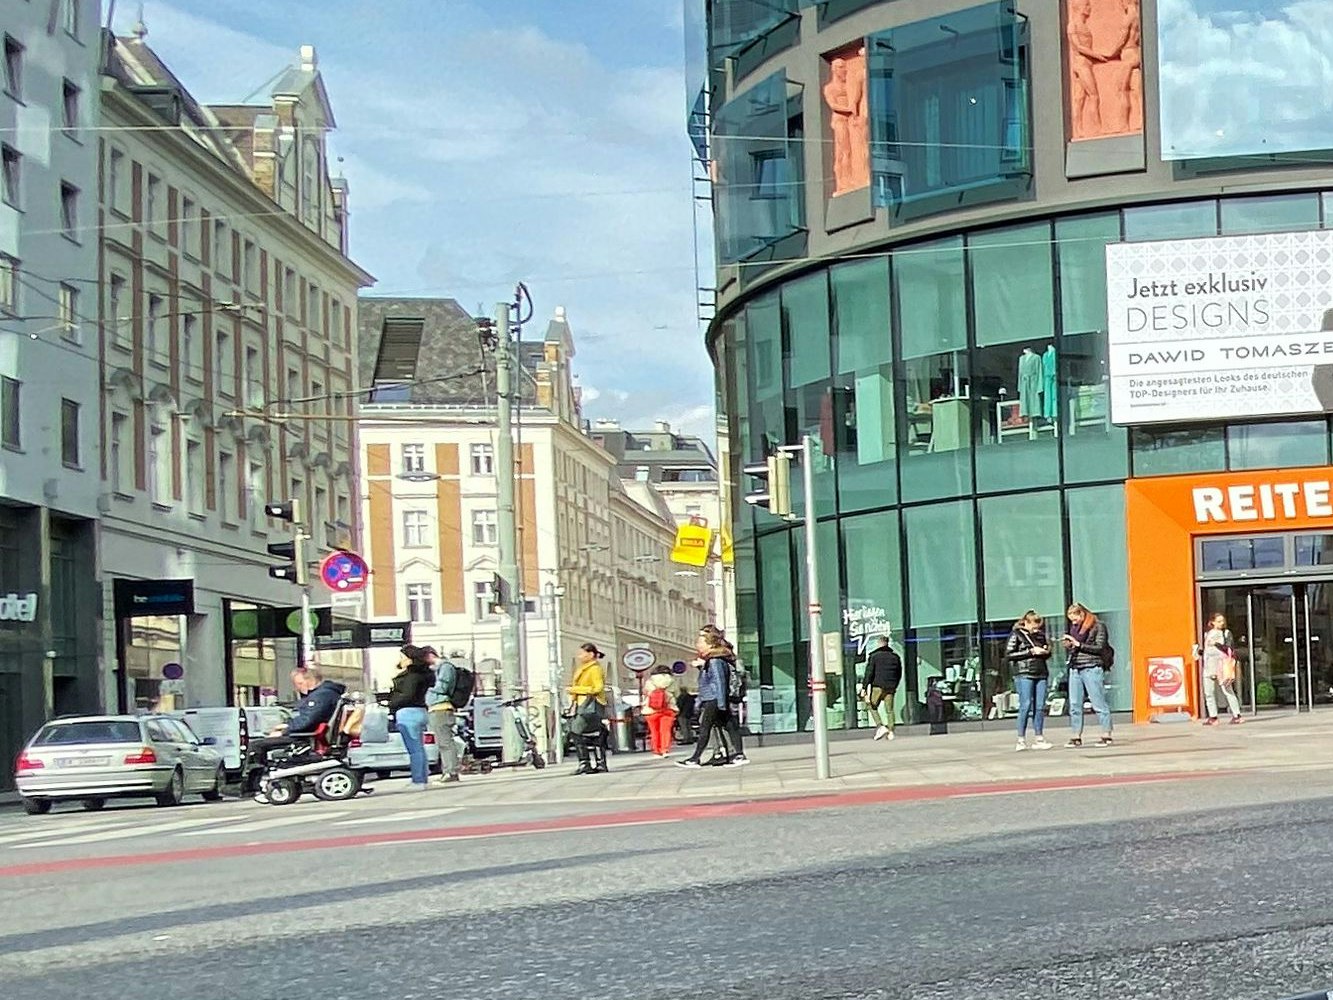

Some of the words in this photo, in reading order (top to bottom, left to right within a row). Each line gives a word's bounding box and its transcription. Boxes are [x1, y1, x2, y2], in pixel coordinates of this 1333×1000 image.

[1127, 278, 1179, 299] Jetzt
[1184, 271, 1268, 296] exklusiv
[1127, 299, 1270, 332] DESIGNS
[1129, 350, 1205, 365] DAWID
[1129, 379, 1144, 388] Die
[1243, 373, 1259, 381] des
[1261, 370, 1309, 380] deutschen
